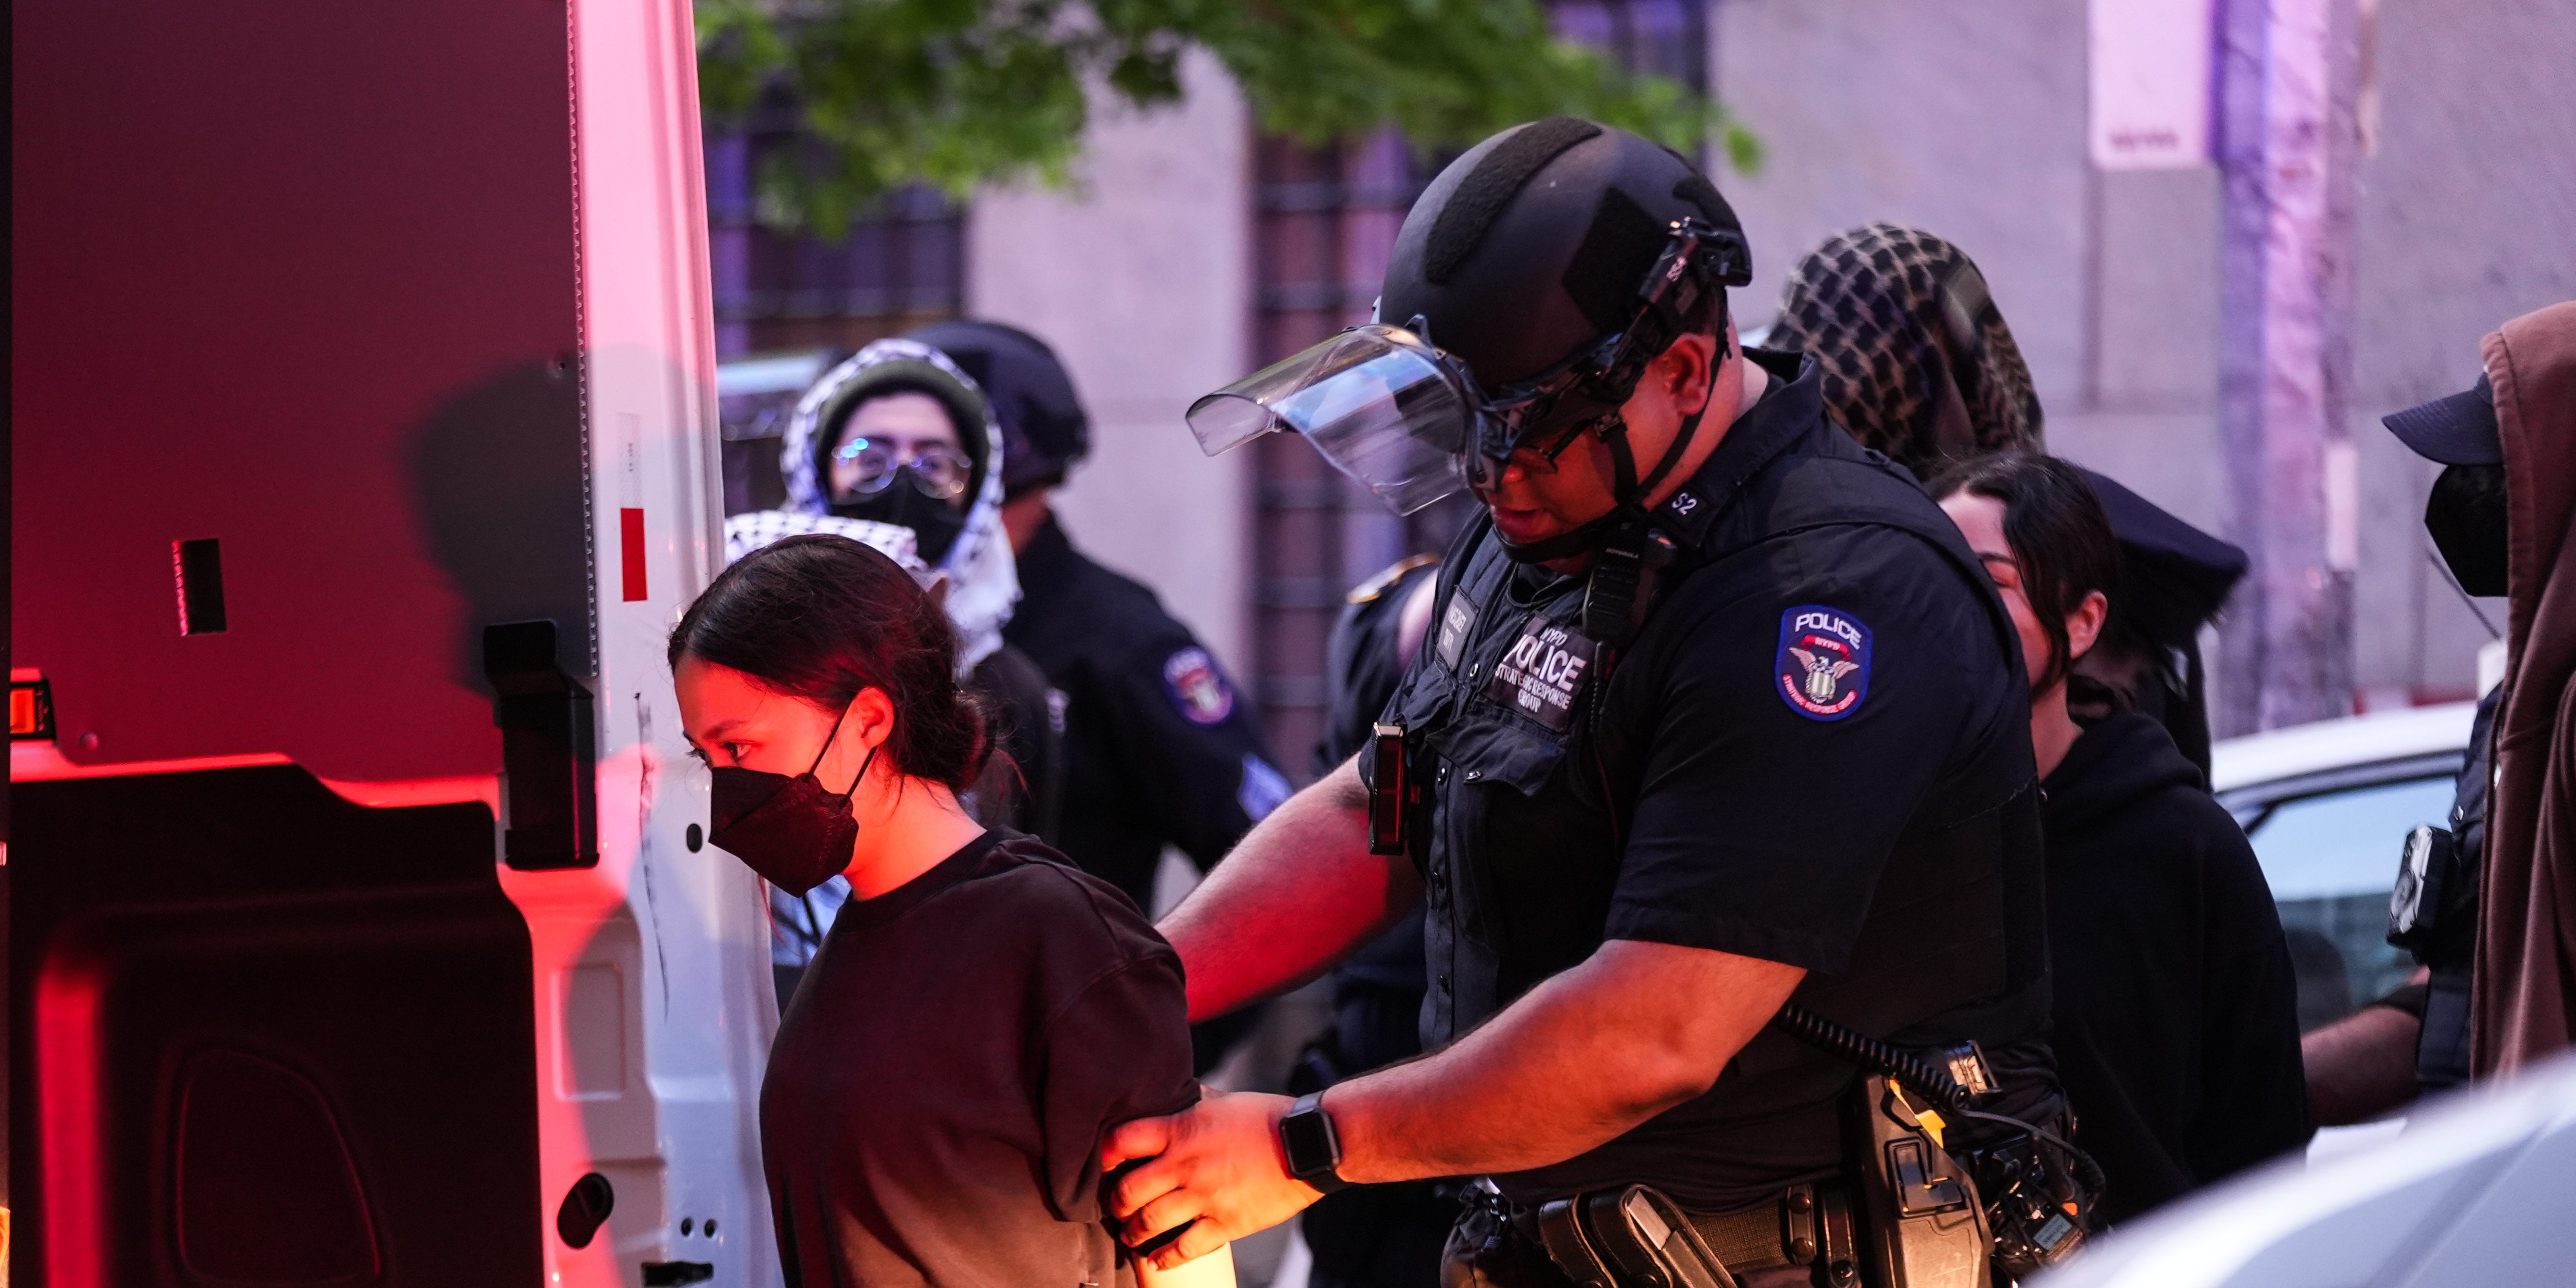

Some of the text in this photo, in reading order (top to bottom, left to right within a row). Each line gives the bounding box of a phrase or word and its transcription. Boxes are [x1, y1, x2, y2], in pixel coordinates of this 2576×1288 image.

[1672, 493, 1697, 515] S2
[1540, 627, 1568, 646] NYPD
[1794, 612, 1862, 650] POLICE
[1518, 689, 1541, 713] GROUP
[1532, 679, 1572, 710] RESPONSE
